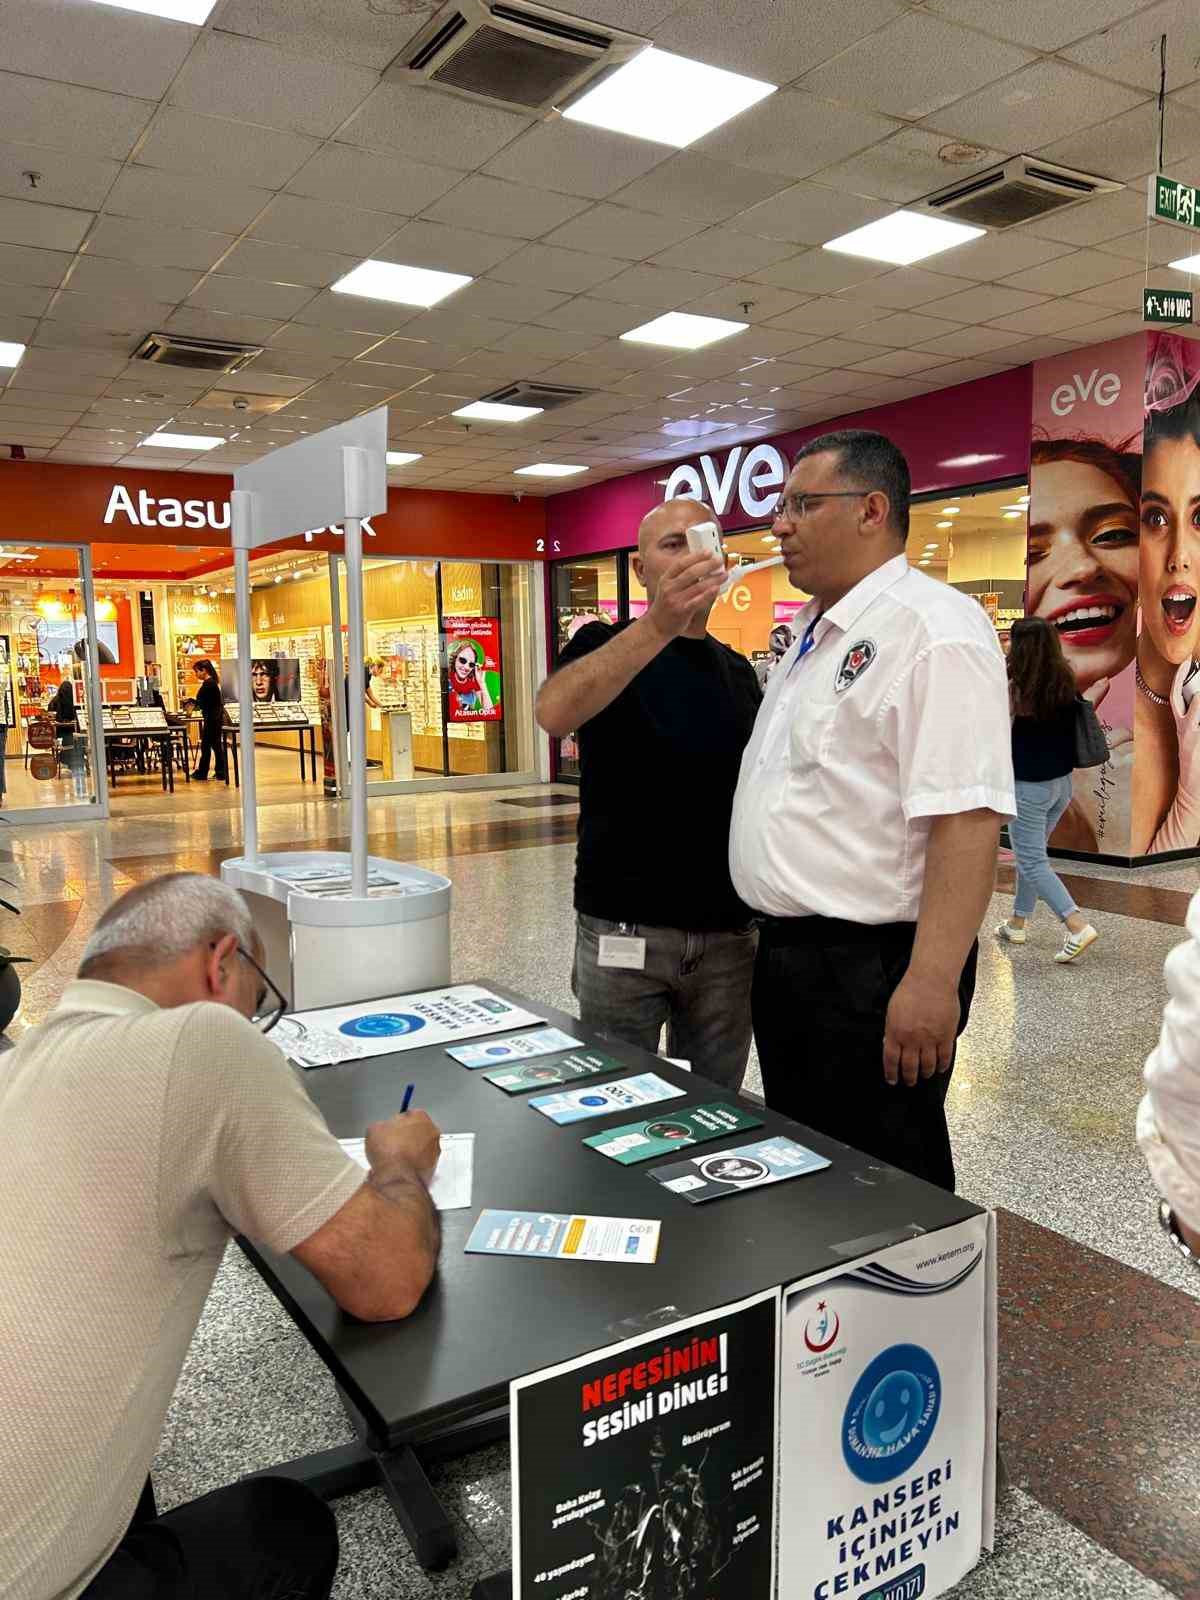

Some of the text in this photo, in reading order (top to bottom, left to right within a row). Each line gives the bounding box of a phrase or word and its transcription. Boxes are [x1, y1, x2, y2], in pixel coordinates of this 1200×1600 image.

[1159, 186, 1176, 211] EXIT
[1176, 299, 1191, 319] WC
[1051, 368, 1122, 417] eve
[103, 484, 231, 530] Atasu
[665, 444, 784, 518] eve
[915, 1242, 976, 1271] www.ketem.org
[582, 1337, 718, 1414] NEFESİNİN
[582, 1392, 653, 1448] SESİNİ
[827, 1459, 952, 1540] KANSERİ
[839, 1495, 942, 1564] İÇİNİZE
